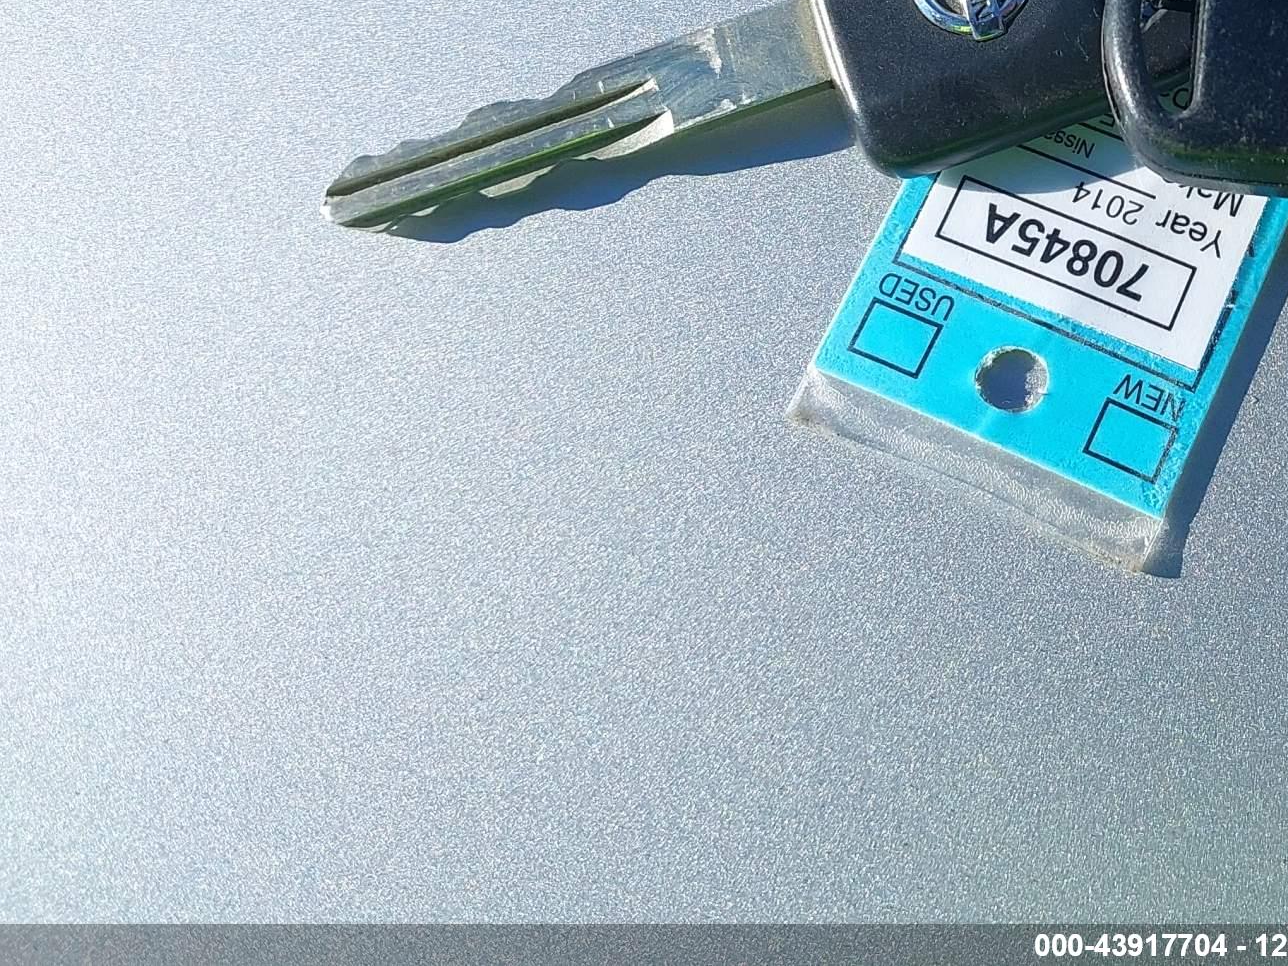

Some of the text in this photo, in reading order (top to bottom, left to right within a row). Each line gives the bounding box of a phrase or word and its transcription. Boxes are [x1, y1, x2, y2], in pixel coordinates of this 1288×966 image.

[986, 202, 1152, 302] 70845A
[1072, 181, 1223, 259] Year 2014
[878, 271, 955, 322] USED
[1113, 373, 1186, 422] NEW
